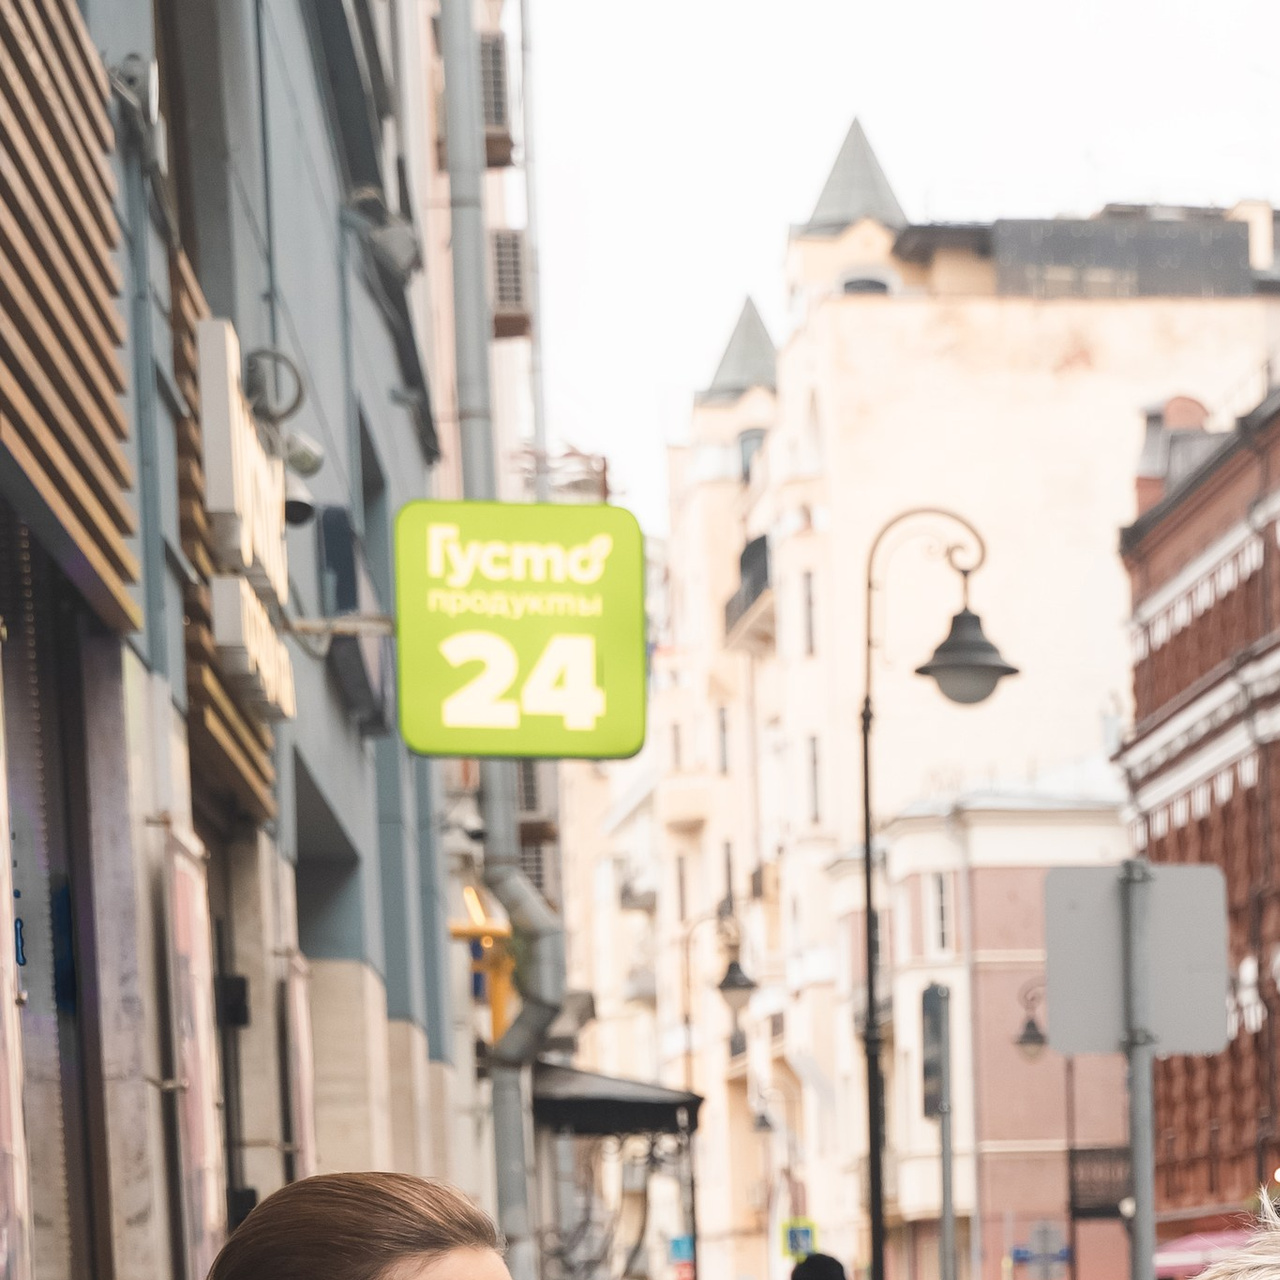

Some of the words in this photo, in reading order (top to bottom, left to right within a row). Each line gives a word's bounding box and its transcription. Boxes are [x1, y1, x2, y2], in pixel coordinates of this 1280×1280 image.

[428, 523, 613, 588] Густо
[428, 588, 602, 619] продукты
[439, 630, 606, 731] 24
